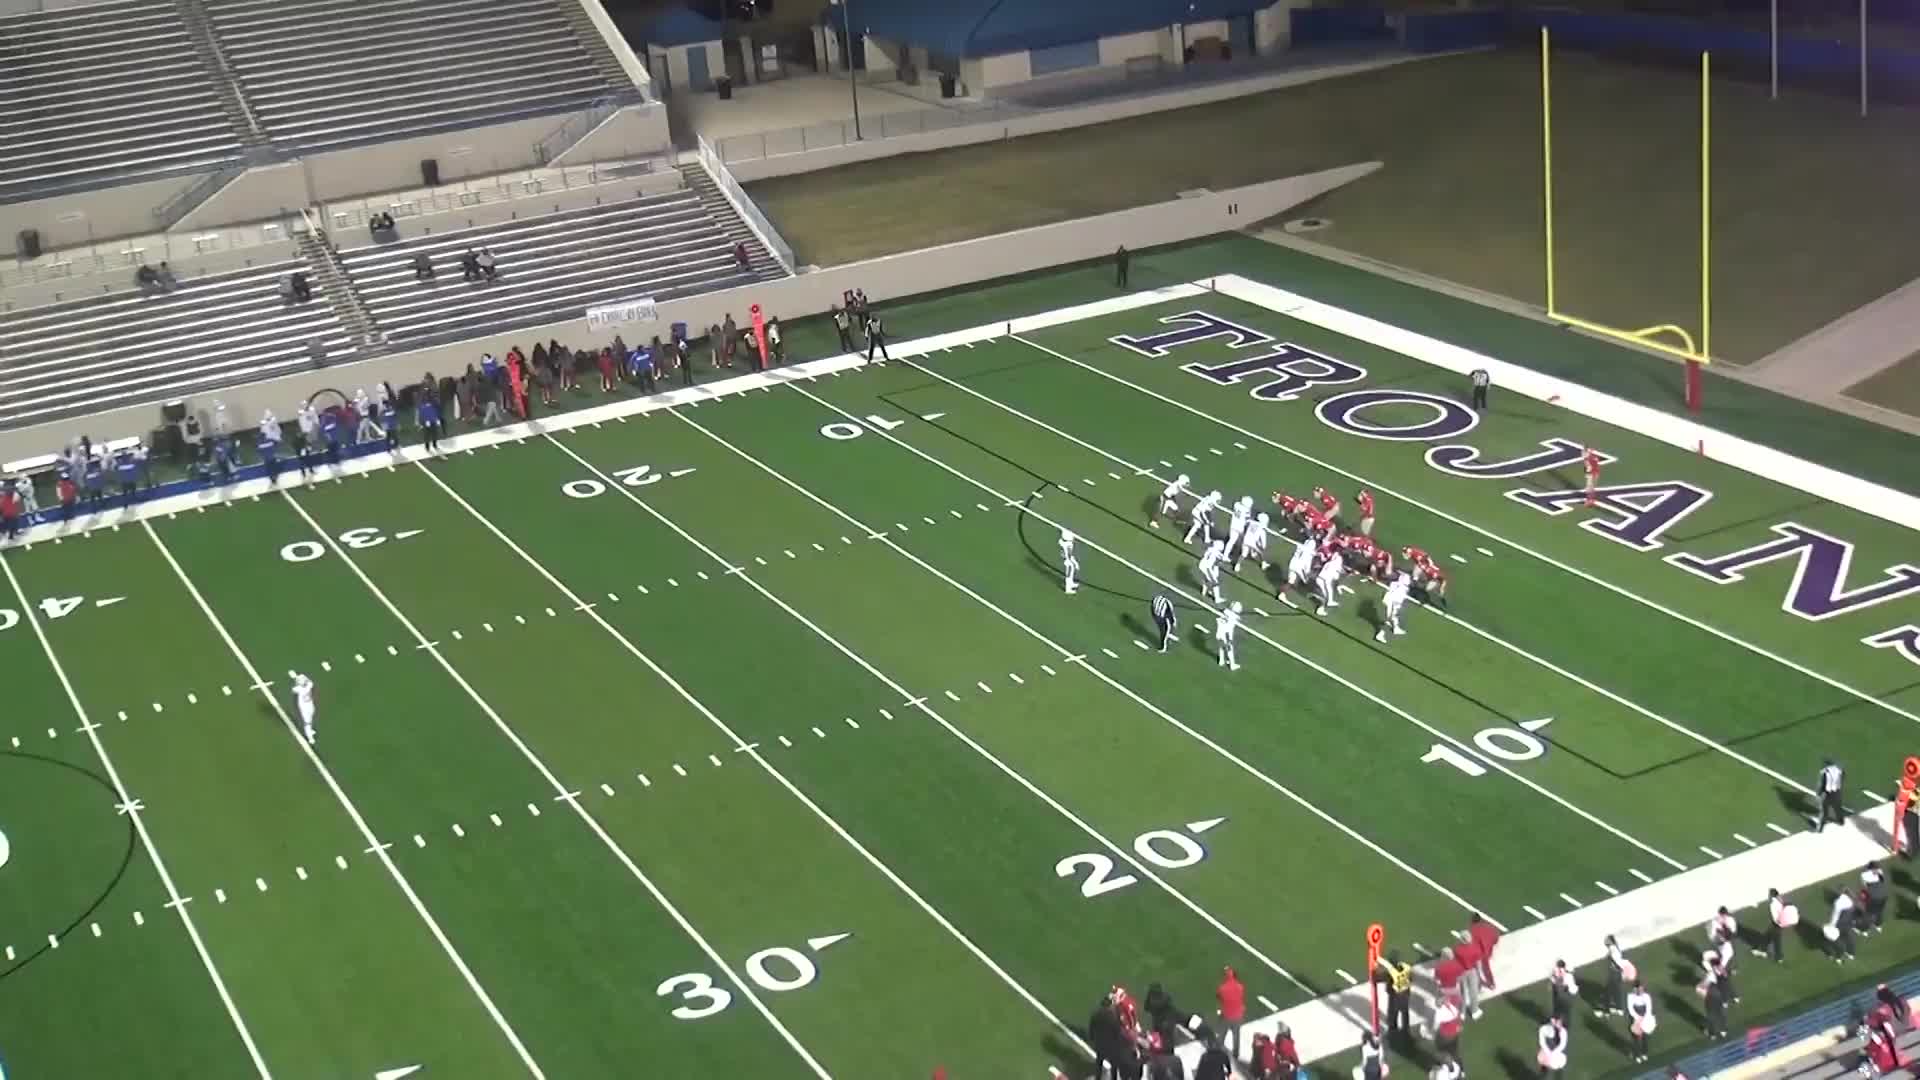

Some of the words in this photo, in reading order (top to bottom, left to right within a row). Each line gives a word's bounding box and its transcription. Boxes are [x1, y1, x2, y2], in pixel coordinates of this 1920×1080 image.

[820, 414, 905, 440] 10
[561, 464, 662, 498] 20
[280, 527, 387, 562] 30
[1420, 727, 1545, 777] 10
[1056, 829, 1206, 898] 20
[657, 947, 818, 1020] 30
